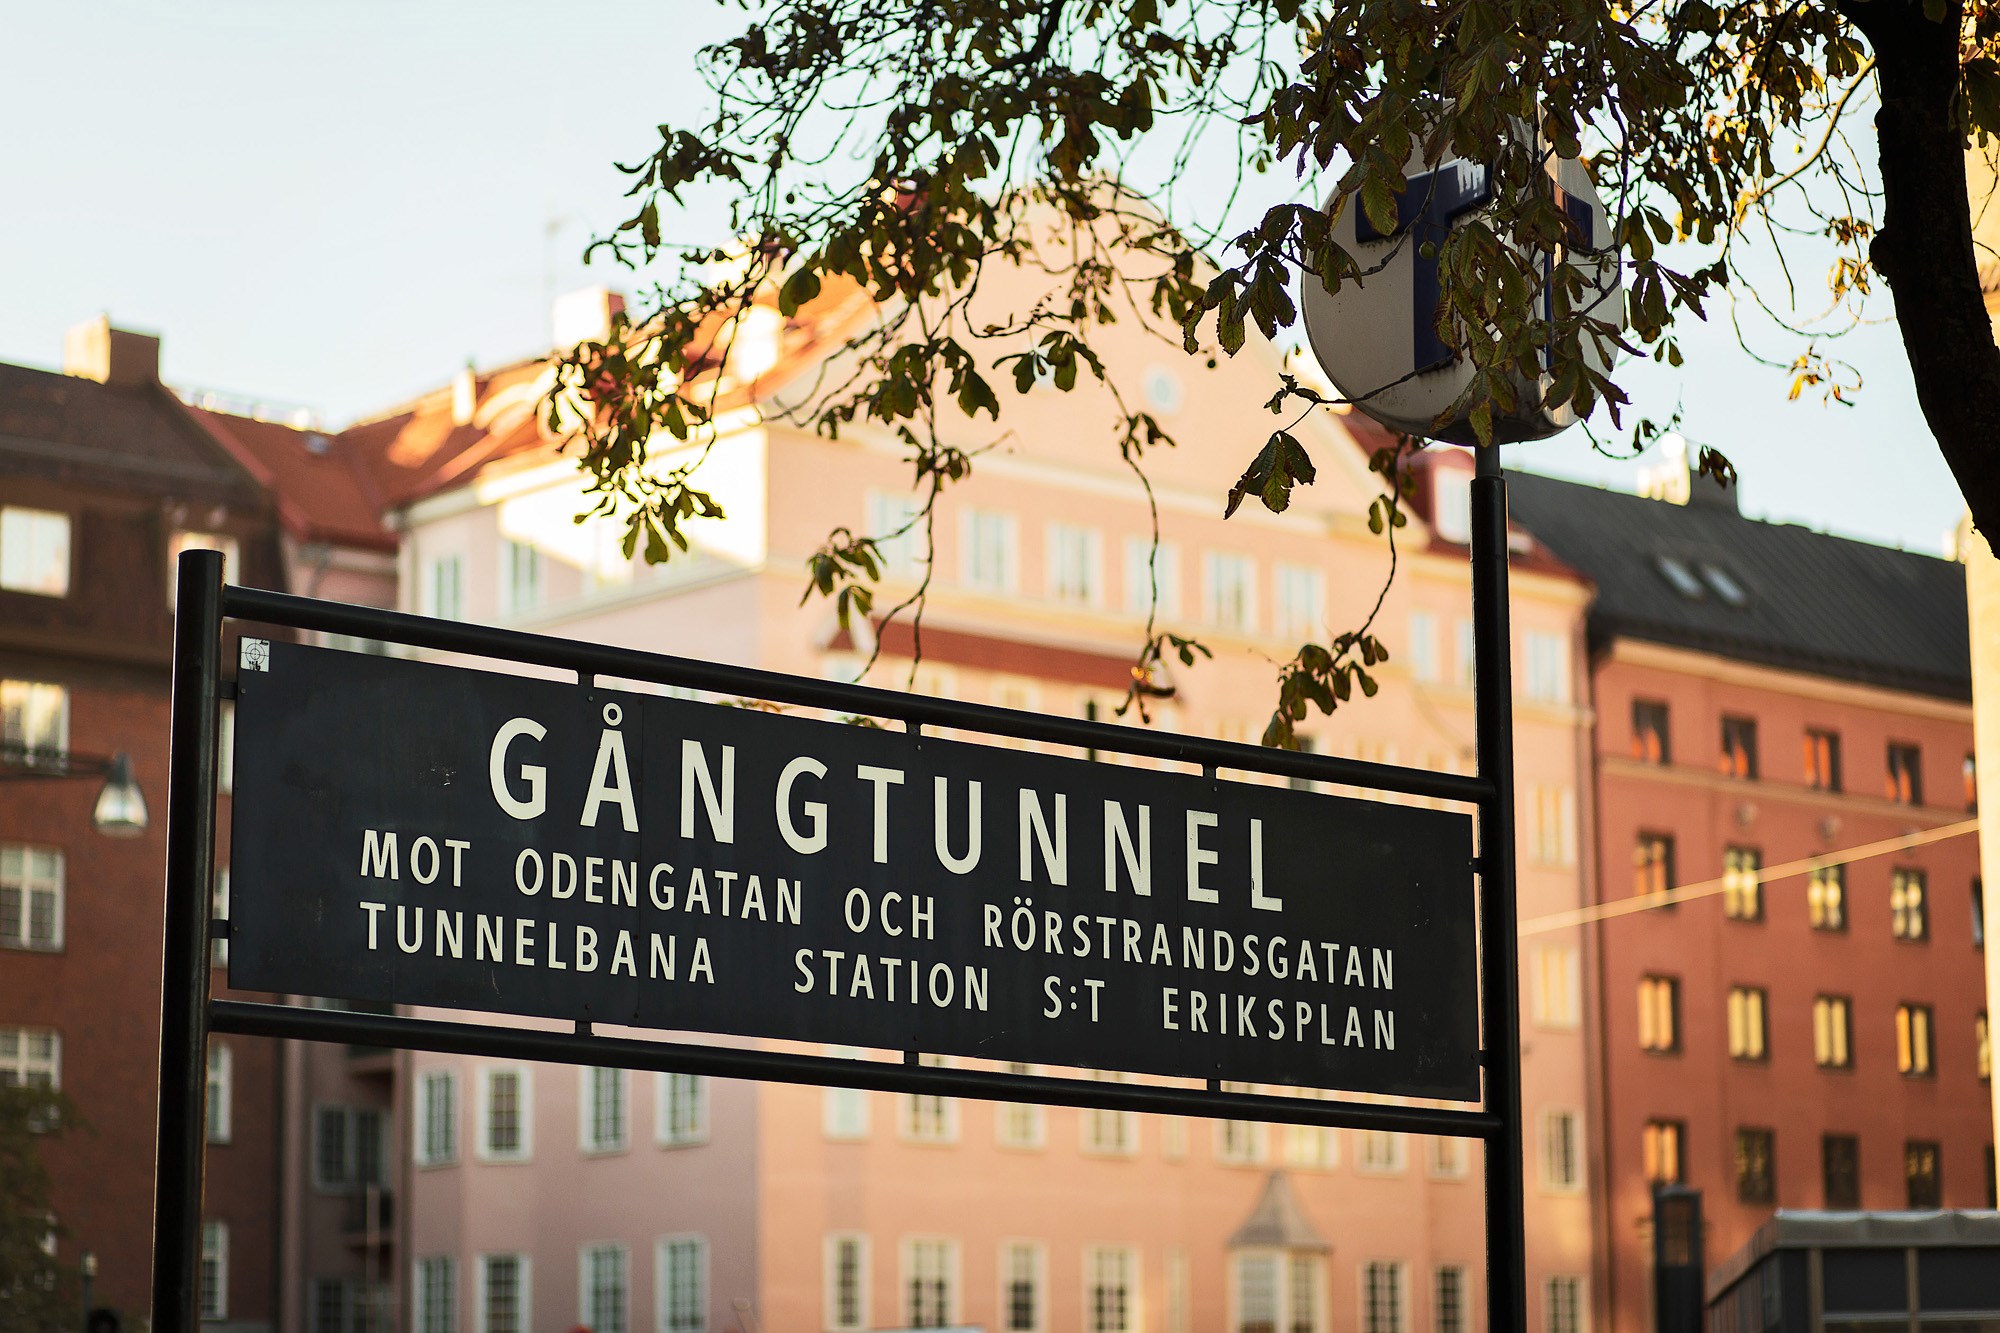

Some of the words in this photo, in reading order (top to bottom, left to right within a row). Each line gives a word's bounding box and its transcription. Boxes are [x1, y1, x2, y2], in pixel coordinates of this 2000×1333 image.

[1354, 157, 1495, 376] T
[489, 702, 1283, 912] GÅNGTUNNEL
[360, 829, 471, 887] MOT
[515, 848, 802, 925] ODENGATAN
[844, 887, 935, 940] OCH
[984, 896, 1393, 990] RÖRSTRANDSGATAN
[360, 901, 715, 984] TUNNELBANA
[794, 948, 989, 1012] STATION
[1043, 975, 1105, 1022] S:T
[1162, 987, 1396, 1051] ERIKSPLAN
